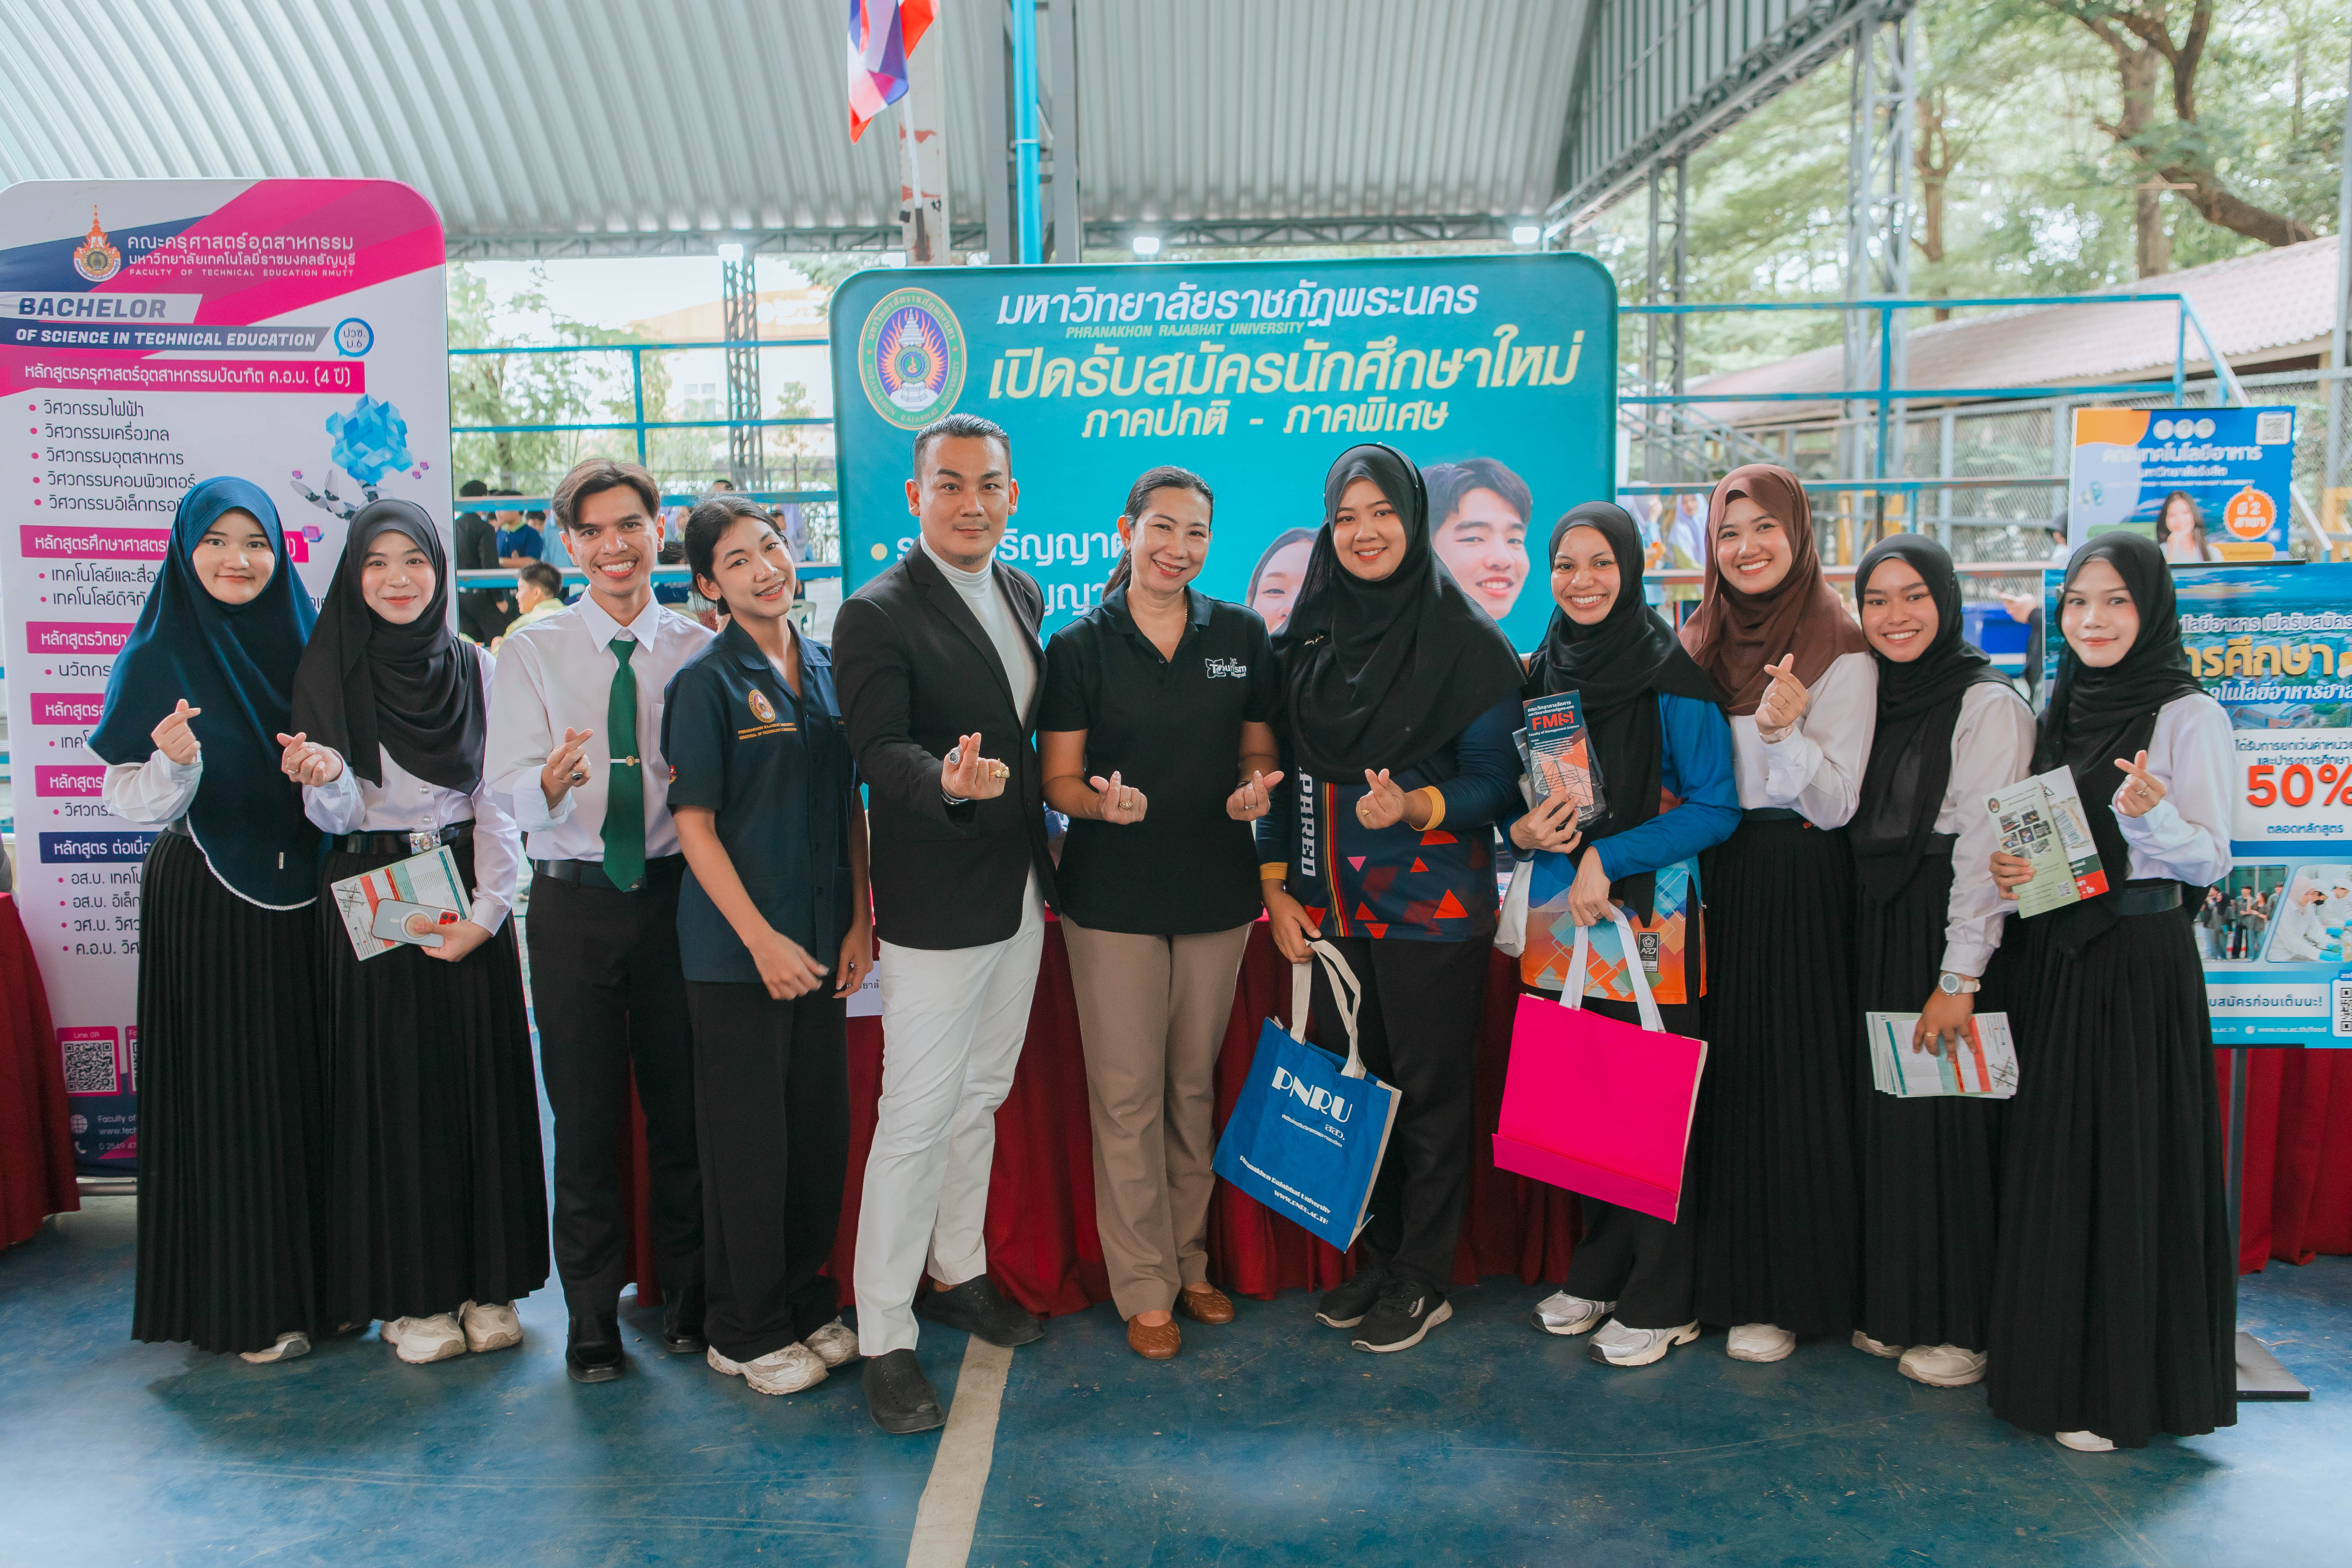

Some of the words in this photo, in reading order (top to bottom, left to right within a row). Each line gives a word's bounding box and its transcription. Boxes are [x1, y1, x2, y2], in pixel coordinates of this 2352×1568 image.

[128, 232, 354, 253] คณะครุศาสตร์อุตสาหกรรม
[129, 252, 355, 268] มหาวิทยาลัยเทคโนโลยีราชมงคลธัญบุรี
[263, 269, 318, 277] EDUCATION
[18, 297, 166, 318] BACHELOR
[996, 279, 1479, 327] มหาวิทยาลัยราชภัฏพระนคร
[16, 328, 37, 341] OF
[41, 329, 109, 345] SCIENCE
[114, 332, 129, 344] IN
[135, 332, 222, 346] TECHNICAL
[227, 333, 316, 347] EDUCATION
[1066, 325, 1152, 338] PHRANAKHON
[1158, 323, 1225, 337] RAJABHAT
[1229, 322, 1305, 335] UNIVERSITY
[988, 323, 1585, 400] เปิดรับสมัครนักศึกษาใหม่
[25, 363, 263, 386] หลักสูตรครุศาสตร์อุตสาหกรรมบัณฑิต
[269, 371, 309, 384] ค.อ.บ.
[314, 367, 329, 387] (4
[334, 367, 351, 387] ปี)
[44, 398, 144, 417] วิศวกรรมไฟฟ้า
[1081, 399, 1231, 438] ภาคปกติ
[1283, 396, 1449, 434] ภาคพิเศษ
[45, 421, 169, 441] วิศวกรรมเครื่องกล
[47, 447, 184, 469] วิศวกรรมอุตสาหการ
[47, 471, 196, 488] วิศวกรรมคอมพิวเตอร์
[35, 534, 169, 554] หลักสูตรศึกษาศาสตร
[51, 562, 159, 583] เทคโนโลยีและสื่อ
[53, 586, 149, 606] เทคโนโลยีดิจิทั
[2179, 614, 2262, 633] โลยีอาหาร
[41, 629, 127, 650] หลักสูตรวิทยา
[2185, 635, 2334, 678] ารศึกษา
[59, 662, 110, 677] นวัตกร
[2202, 680, 2352, 701] คโนโลยีอาหารฮาล
[50, 773, 104, 792] หลักสูตร
[2247, 764, 2352, 807] 50%
[65, 803, 115, 816] วิศวกร
[1299, 767, 1316, 877] PARED
[54, 839, 108, 859] หลักสูตร
[112, 835, 151, 855] ต่อเนื่อ
[71, 873, 105, 884] อส.บ.
[73, 896, 107, 908] อส.บ.
[74, 919, 110, 931] วศ.บ.
[76, 943, 116, 955] ค.อ.บ.
[861, 979, 880, 989] ยาลั
[2208, 994, 2323, 1007] บสมัครก่อนเต็มนะ!
[1271, 1066, 1353, 1123] PNRU
[1301, 1193, 1331, 1214] University
